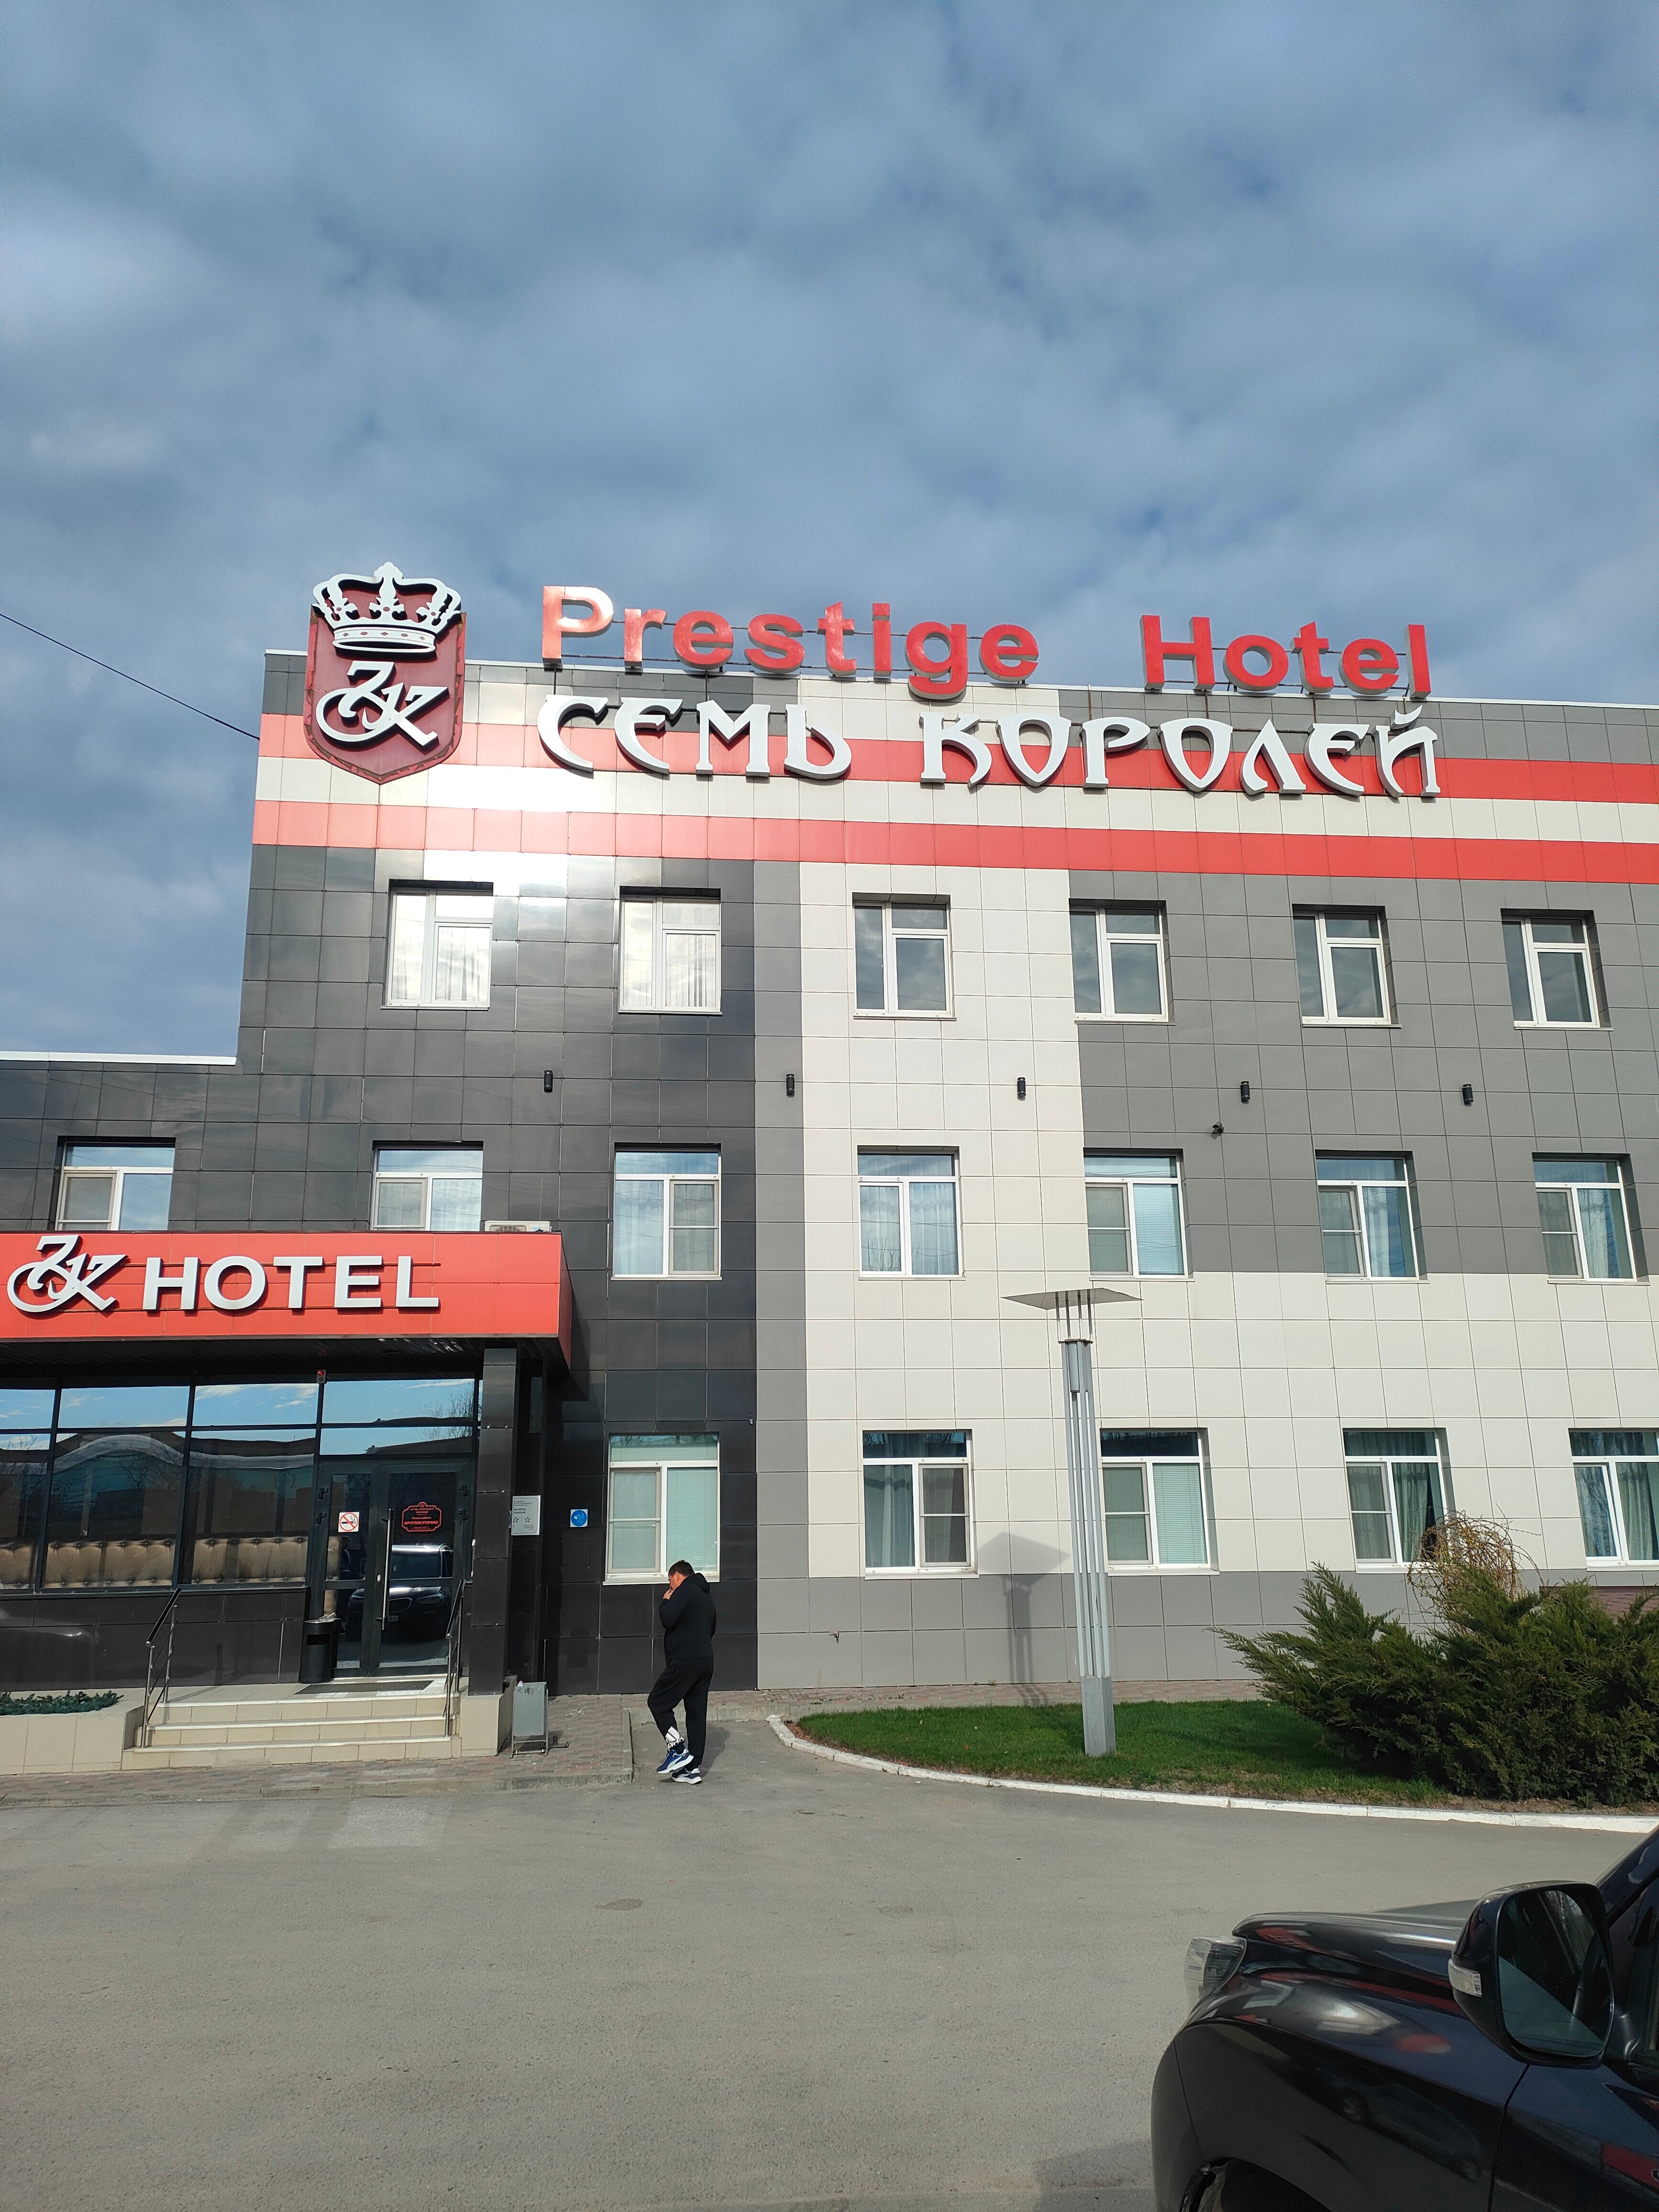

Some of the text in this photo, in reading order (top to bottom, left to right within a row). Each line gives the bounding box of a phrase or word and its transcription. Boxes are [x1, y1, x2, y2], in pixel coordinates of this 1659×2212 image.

[542, 585, 1432, 700] Prestige Hotel
[538, 694, 1441, 798] СЕМЬ КОРОЛЕЙ
[142, 1255, 440, 1311] HOTEL
